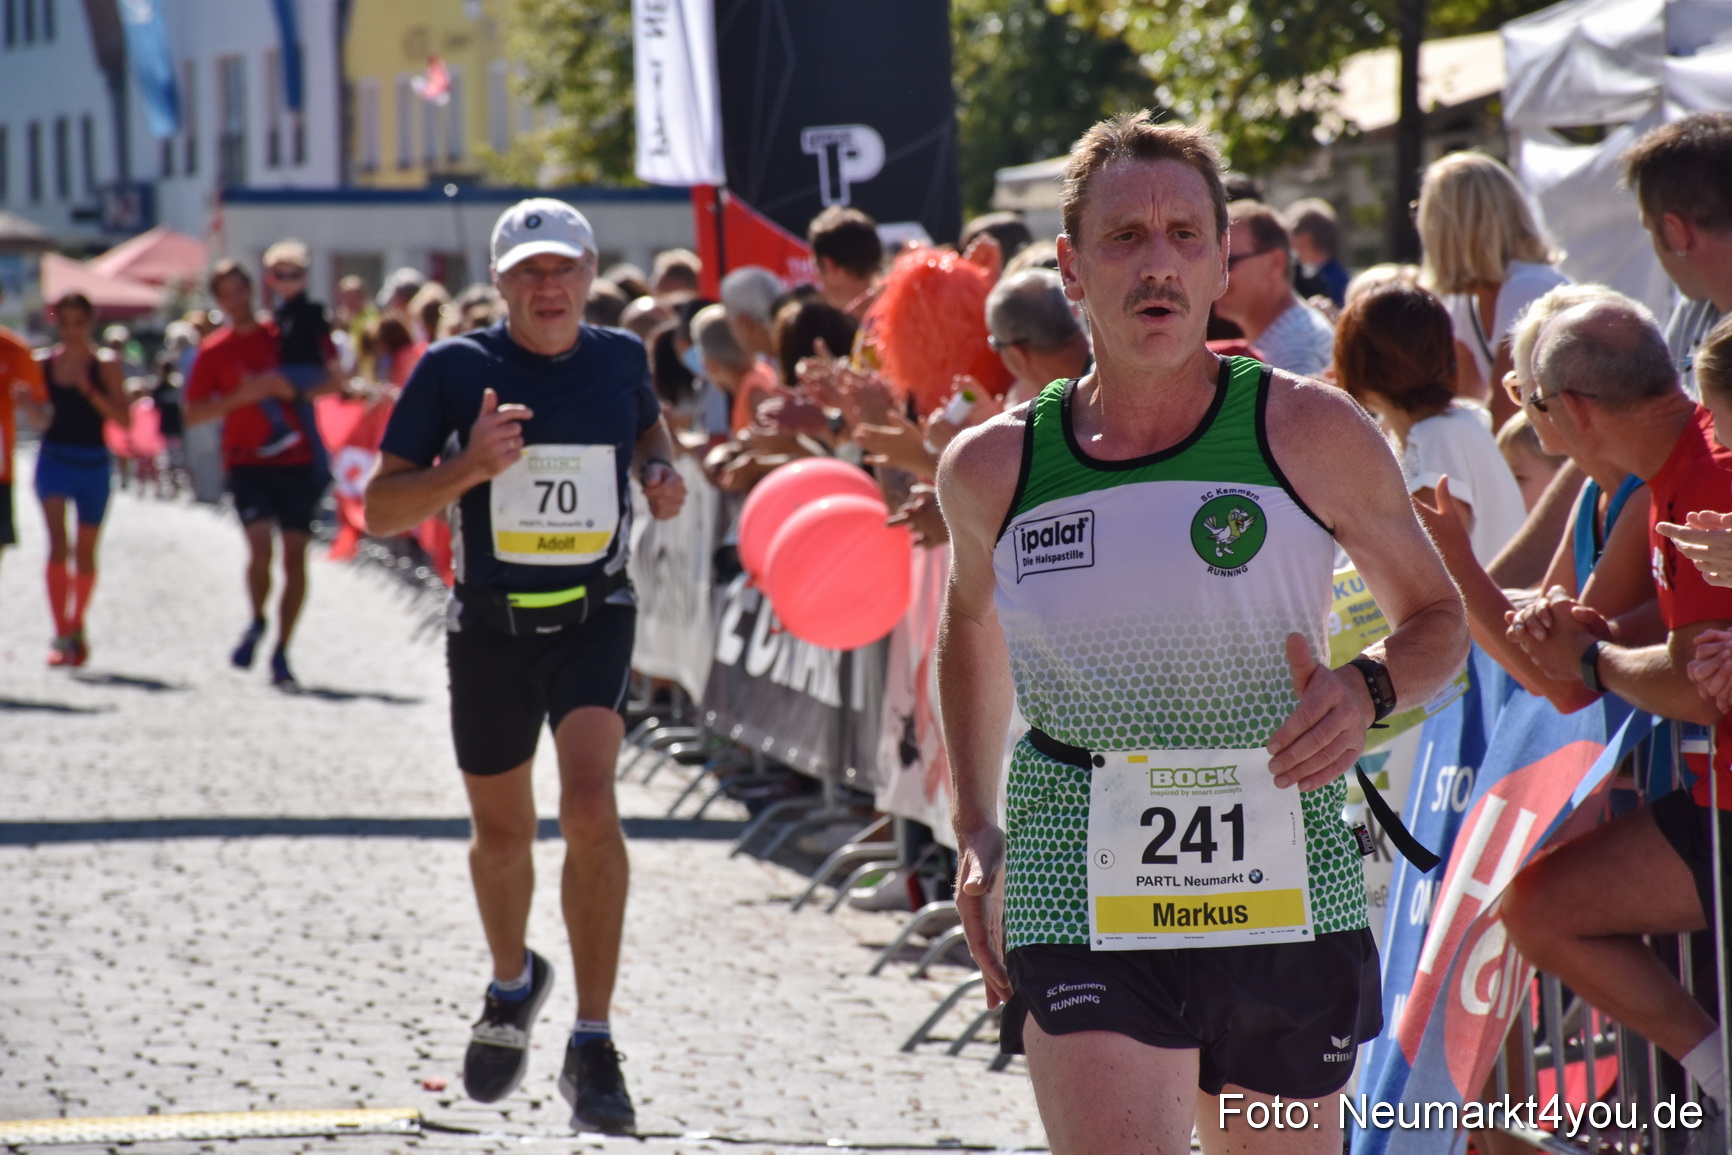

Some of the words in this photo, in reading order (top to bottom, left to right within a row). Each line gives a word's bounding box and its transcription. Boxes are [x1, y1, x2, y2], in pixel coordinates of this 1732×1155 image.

[534, 480, 577, 514] 70
[1200, 491, 1214, 502] SC
[1216, 487, 1260, 501] Kemmern
[537, 536, 575, 551] Adolf
[1022, 557, 1034, 567] Die
[1035, 549, 1084, 564] Halspastille
[1207, 565, 1249, 578] RUNNING
[1150, 765, 1240, 788] BOCK
[1150, 789, 1179, 797] inspired
[1191, 788, 1212, 796] smart
[1213, 787, 1242, 795] concepts
[1140, 803, 1244, 865] 241
[1100, 854, 1108, 864] C
[1136, 876, 1181, 887] PARTL
[1184, 873, 1244, 887] Neumarkt
[1153, 902, 1249, 927] Markus
[1046, 986, 1058, 998] SC
[1059, 982, 1107, 993] Kemmern
[1050, 994, 1101, 1012] RUNNING
